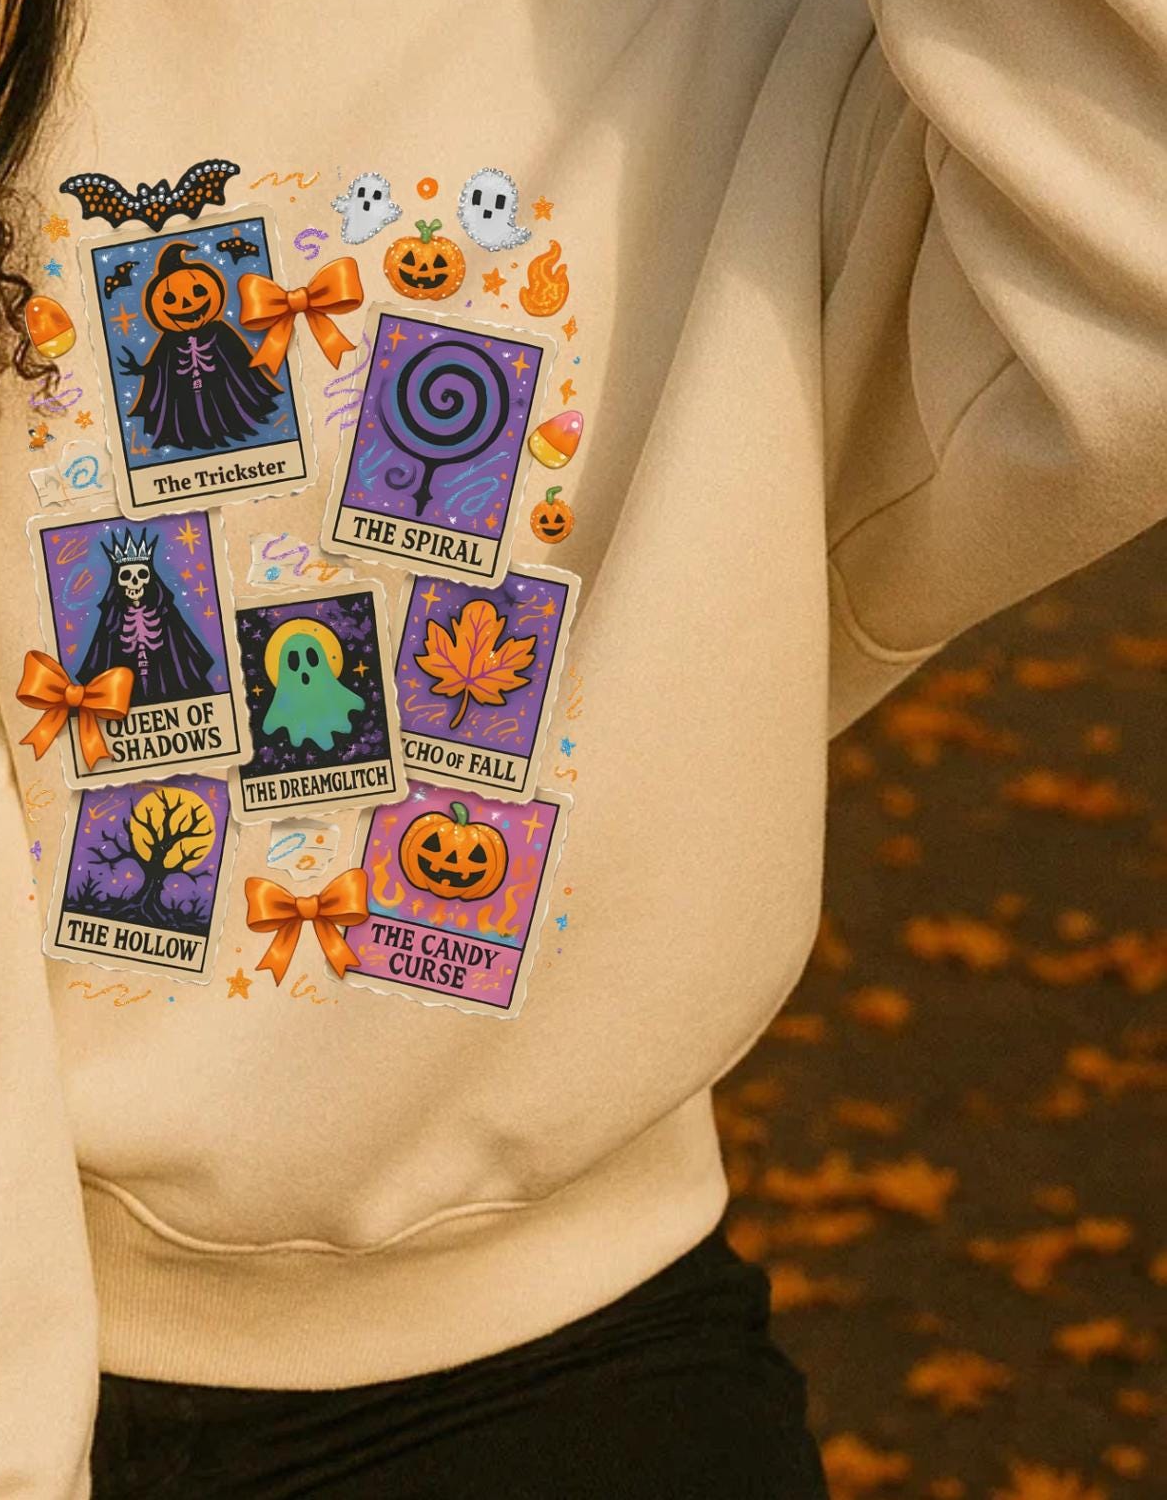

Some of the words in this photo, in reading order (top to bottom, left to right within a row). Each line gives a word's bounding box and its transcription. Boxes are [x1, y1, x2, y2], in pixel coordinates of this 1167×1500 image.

[153, 475, 191, 495] The
[194, 460, 286, 488] Trickster
[353, 516, 397, 545] THE
[401, 528, 483, 566] SPIRAL
[106, 707, 180, 738] QUEEN
[187, 702, 214, 727] OF
[111, 726, 222, 763] SHADOWS
[401, 738, 443, 764] CHO
[468, 753, 517, 783] FALL
[246, 780, 277, 803] THE
[280, 766, 389, 799] DREAMGLITCH
[67, 919, 109, 947] THE
[113, 929, 202, 962] HOLLOW
[371, 923, 416, 952] THE
[421, 934, 500, 970] CANDY
[388, 952, 467, 990] CURSE
